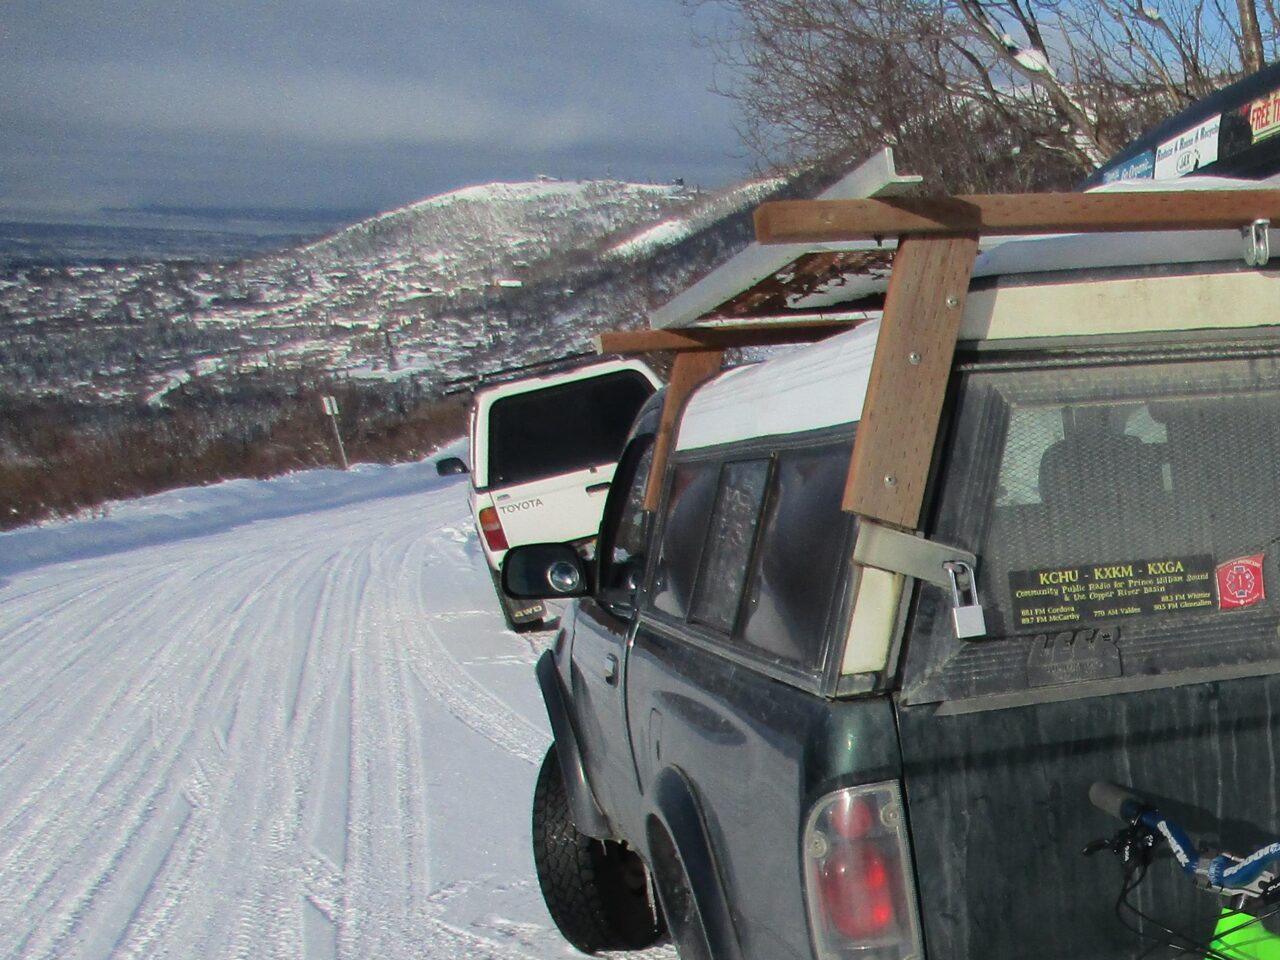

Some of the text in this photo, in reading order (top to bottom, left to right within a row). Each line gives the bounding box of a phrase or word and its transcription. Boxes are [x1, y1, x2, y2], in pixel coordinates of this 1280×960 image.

[1251, 102, 1271, 130] FREE
[500, 498, 543, 515] TOYOTA
[1039, 570, 1079, 585] KCHU
[1094, 565, 1133, 580] KXKM
[1147, 561, 1184, 575] KXGA
[1016, 573, 1209, 598] Community Public Radio for Prince William Sound
[1089, 591, 1115, 601] Copper
[1117, 587, 1140, 597] River
[1143, 585, 1166, 594] Basin
[1035, 608, 1046, 616] FM
[1048, 605, 1075, 614] Cordova
[1036, 616, 1047, 624] FM
[1049, 613, 1080, 622] McCarthy
